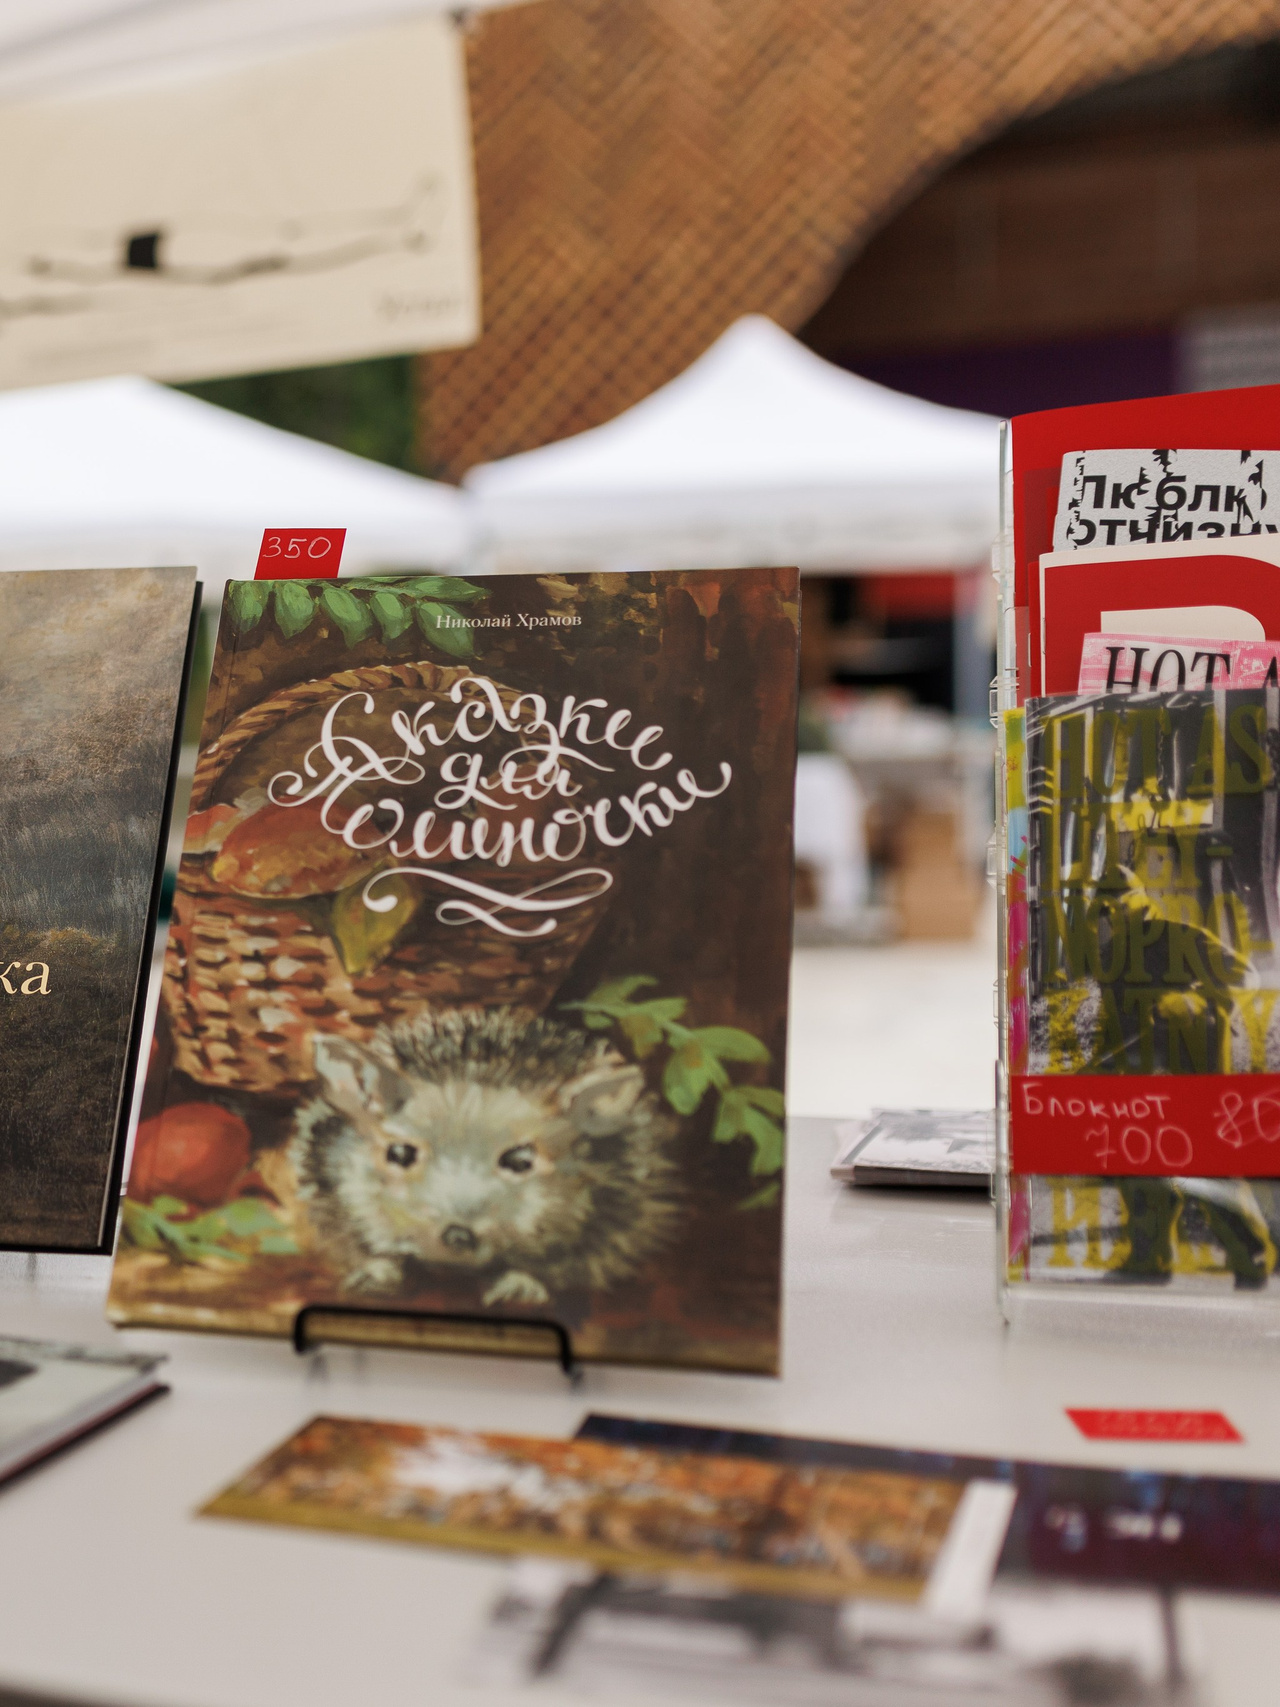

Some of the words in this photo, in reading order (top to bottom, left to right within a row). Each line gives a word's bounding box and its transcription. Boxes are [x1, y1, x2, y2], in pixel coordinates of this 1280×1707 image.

[261, 536, 332, 559] 350
[436, 613, 511, 630] Николай
[516, 612, 582, 631] Храмов
[1023, 1082, 1171, 1120] Блокнот
[1085, 1122, 1194, 1170] 700
